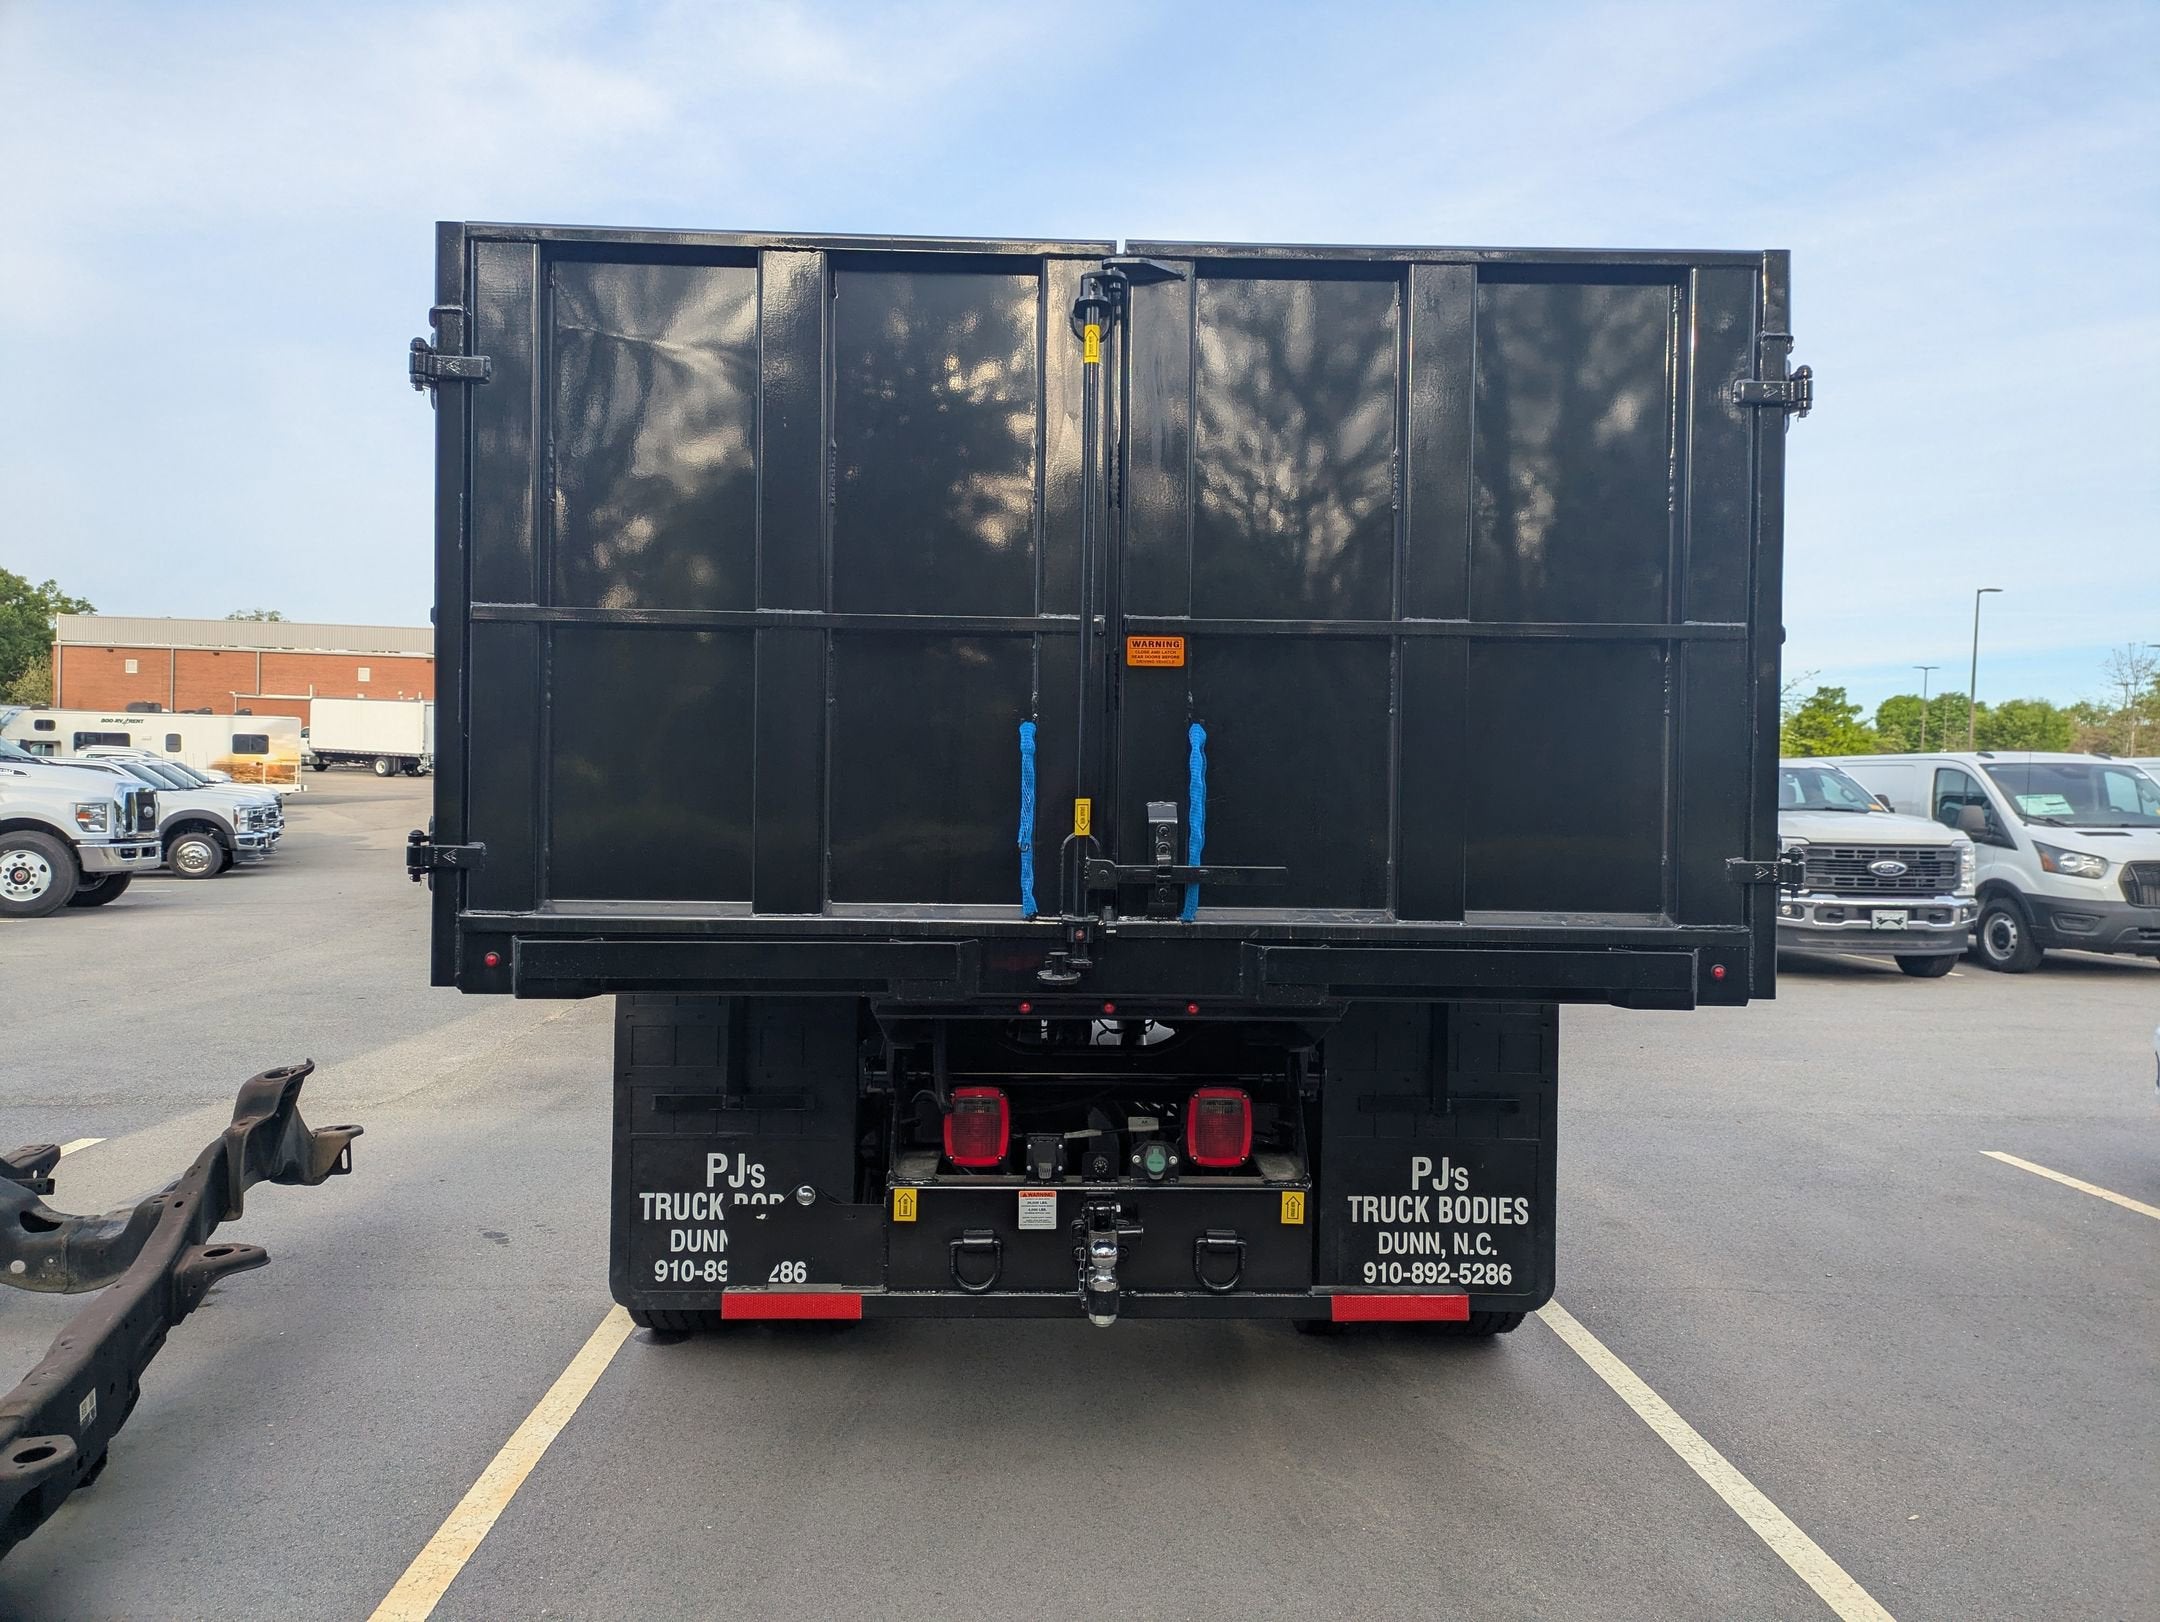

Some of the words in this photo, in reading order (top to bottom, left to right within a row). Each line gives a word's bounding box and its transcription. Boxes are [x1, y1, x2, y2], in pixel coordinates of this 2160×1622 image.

[706, 1152, 766, 1189] PJ's
[1411, 1156, 1469, 1192] PJ's
[639, 1192, 724, 1221] TRUCK
[1347, 1195, 1430, 1223] TRUCK
[1438, 1196, 1529, 1225] BODIES
[1378, 1231, 1446, 1259] DUNN,
[1453, 1232, 1498, 1256] N.C.
[1363, 1261, 1512, 1286] 910-892-5286
